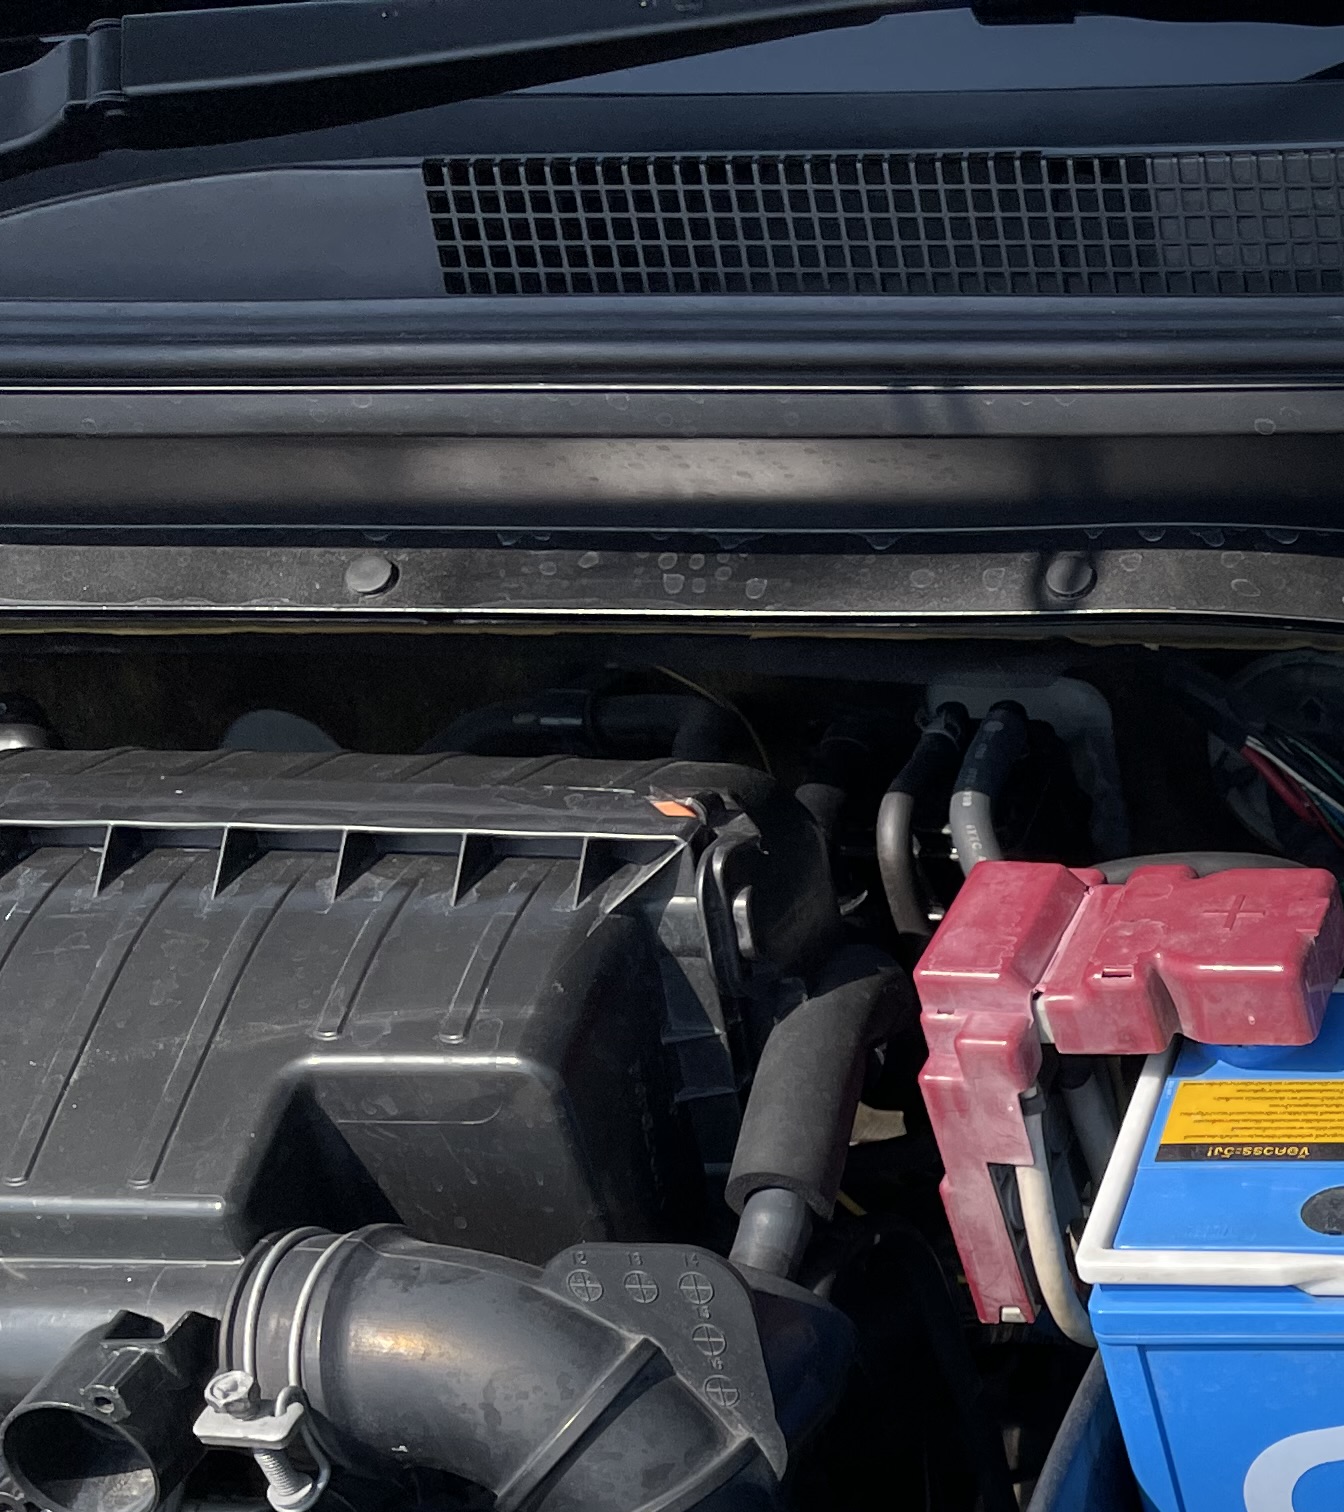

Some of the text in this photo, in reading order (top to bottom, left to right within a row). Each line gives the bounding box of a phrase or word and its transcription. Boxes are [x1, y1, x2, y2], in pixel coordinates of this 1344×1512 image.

[1206, 1145, 1310, 1159] ข้อควรระวัง!
